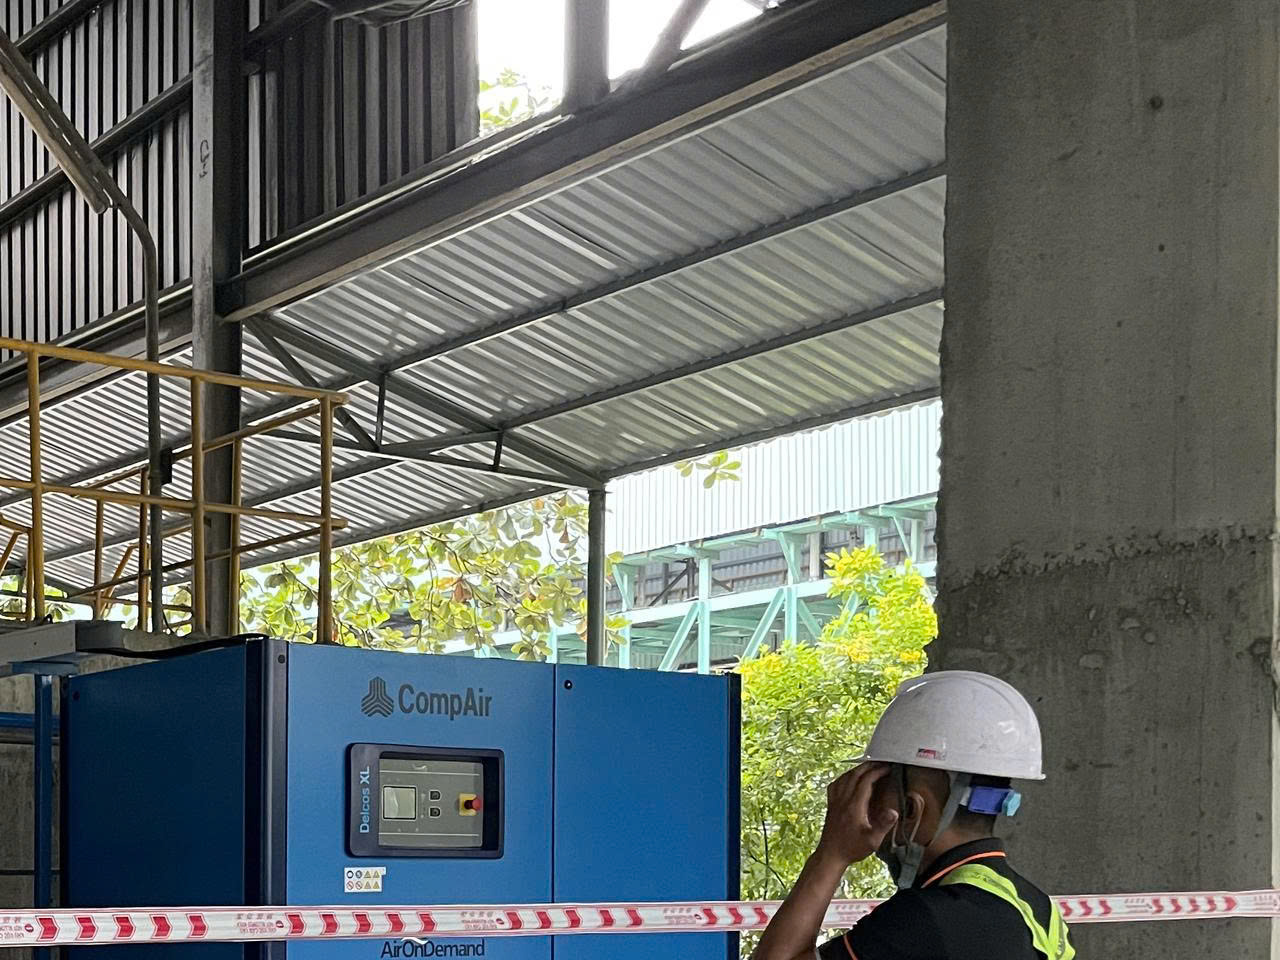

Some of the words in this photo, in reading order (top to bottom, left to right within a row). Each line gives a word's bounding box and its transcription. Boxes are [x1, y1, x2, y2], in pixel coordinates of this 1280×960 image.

[398, 683, 493, 721] CompAir
[358, 766, 371, 784] XL
[358, 785, 371, 834] Delcos
[380, 937, 486, 959] AirOnDemand
